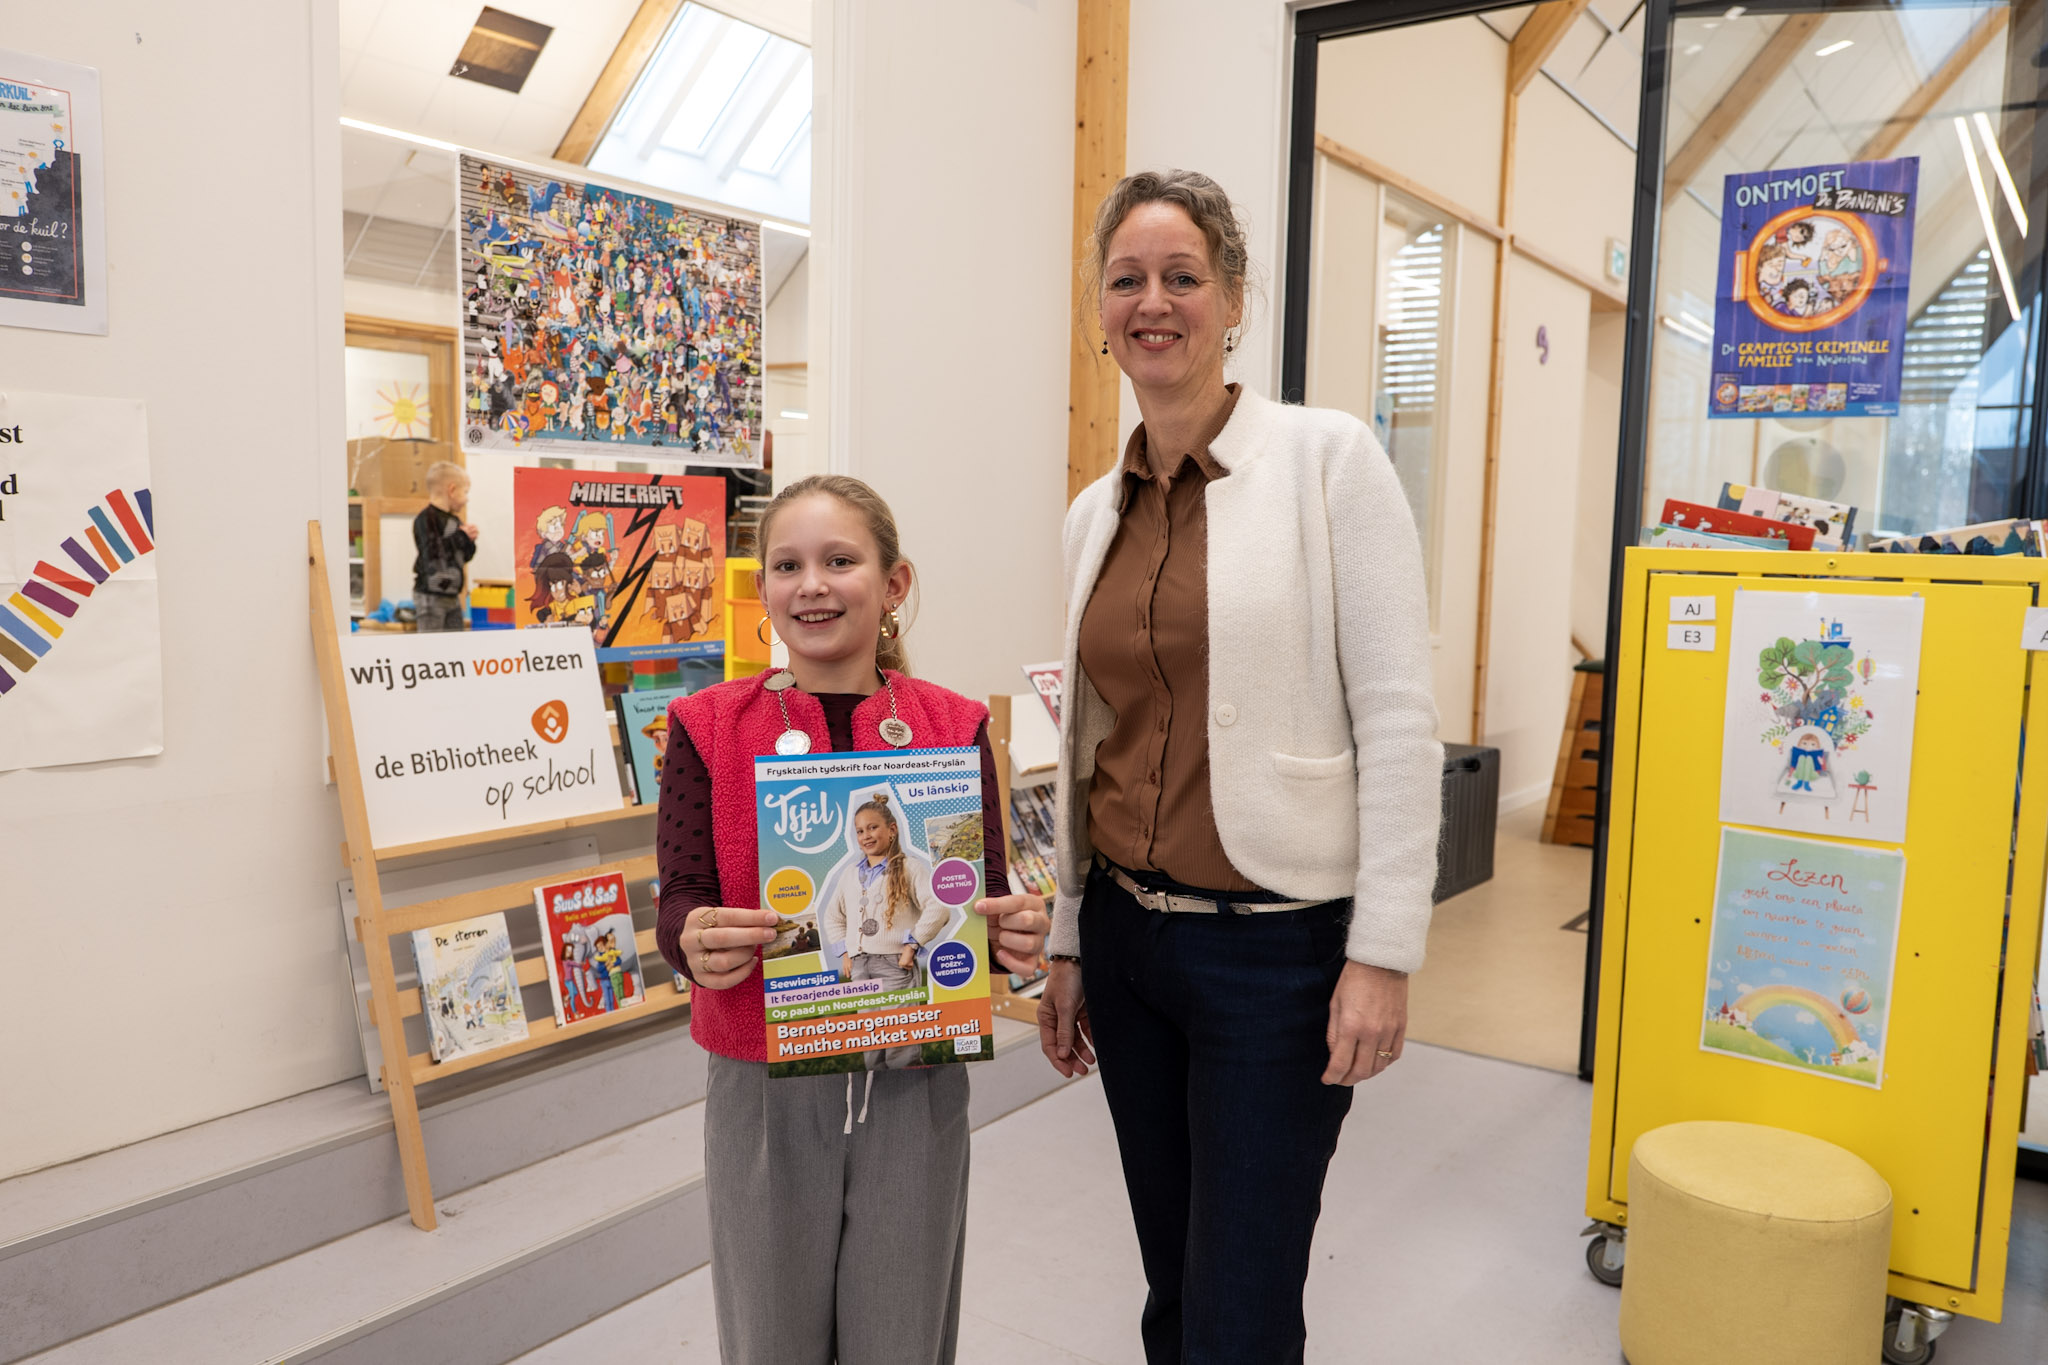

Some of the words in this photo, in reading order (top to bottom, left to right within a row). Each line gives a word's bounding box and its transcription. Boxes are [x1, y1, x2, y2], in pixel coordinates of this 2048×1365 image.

[1736, 170, 1845, 207] ONTMOET
[13, 221, 28, 234] de
[1738, 341, 1813, 355] GRAPPIGSTE
[1815, 340, 1890, 354] CRIMINELE
[1738, 355, 1793, 368] FAMILIE
[569, 482, 684, 510] MINECRAFT
[1685, 604, 1701, 616] AJ
[1684, 630, 1702, 643] E3
[350, 658, 394, 690] wij
[401, 660, 466, 689] gaan
[472, 650, 583, 676] voorlezen
[375, 756, 404, 779] de
[411, 740, 538, 774] Bibliotheek
[766, 766, 818, 776] Frysktalich
[820, 764, 861, 775] tydskrift
[862, 763, 882, 771] foar
[486, 782, 513, 820] op
[523, 749, 596, 800] school
[908, 788, 924, 798] Us
[764, 786, 834, 842] Tsjil
[942, 874, 966, 882] POSTER
[1767, 858, 1848, 894] Lezen
[936, 882, 954, 890] FOAR
[582, 886, 595, 908] &
[436, 937, 449, 947] De
[455, 929, 488, 942] sterren
[770, 974, 836, 990] Seewiersjips
[781, 987, 840, 1004] feroarjende
[842, 982, 880, 994] lânskip
[772, 1010, 788, 1020] Op
[790, 1006, 816, 1018] paad
[818, 1004, 831, 1015] yn
[777, 1008, 942, 1040] Berneboargemaster
[779, 1038, 842, 1056] Menthe
[846, 1030, 908, 1048] makket
[911, 1024, 942, 1039] wat
[946, 1020, 980, 1036] mei!
